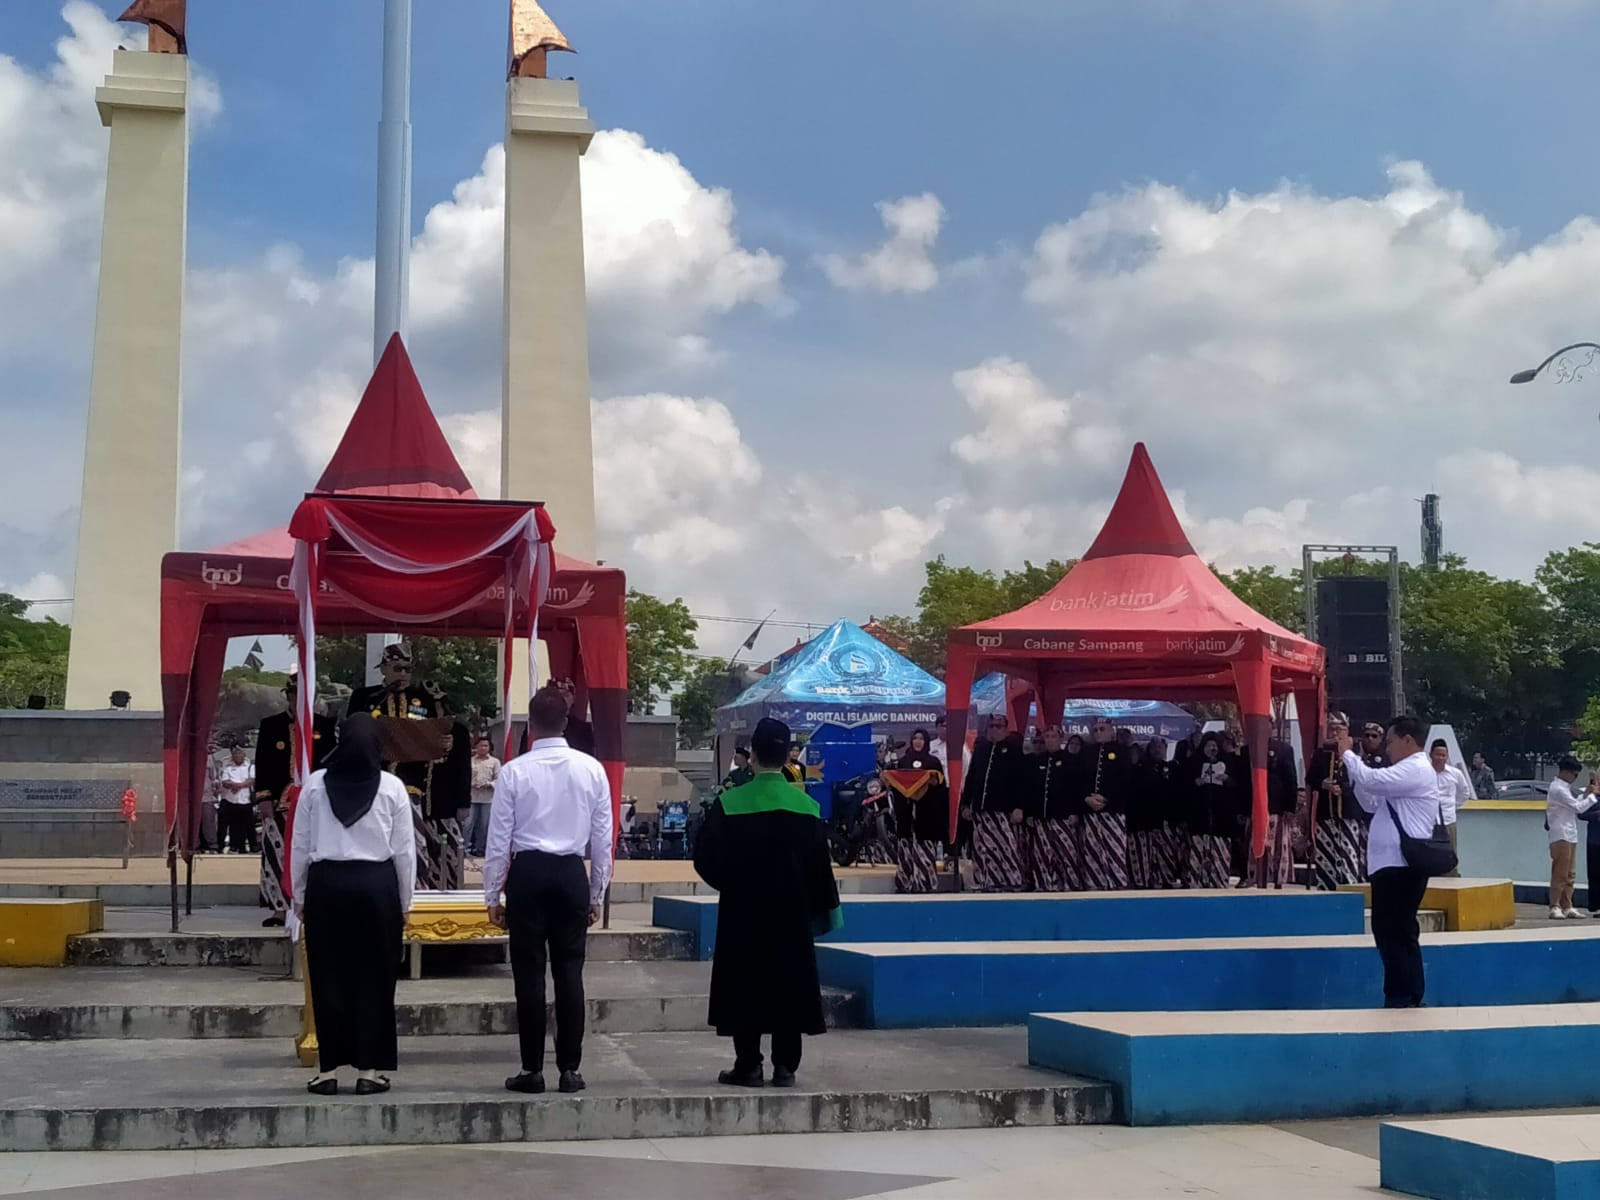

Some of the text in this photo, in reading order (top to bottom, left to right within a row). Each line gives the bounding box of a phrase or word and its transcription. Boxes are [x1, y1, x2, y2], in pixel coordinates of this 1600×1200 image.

[1023, 638, 1144, 653] Cabang Sampang
[806, 711, 846, 721] DIGITAL
[847, 711, 889, 721] ISLAMIC
[890, 712, 937, 722] BANKING
